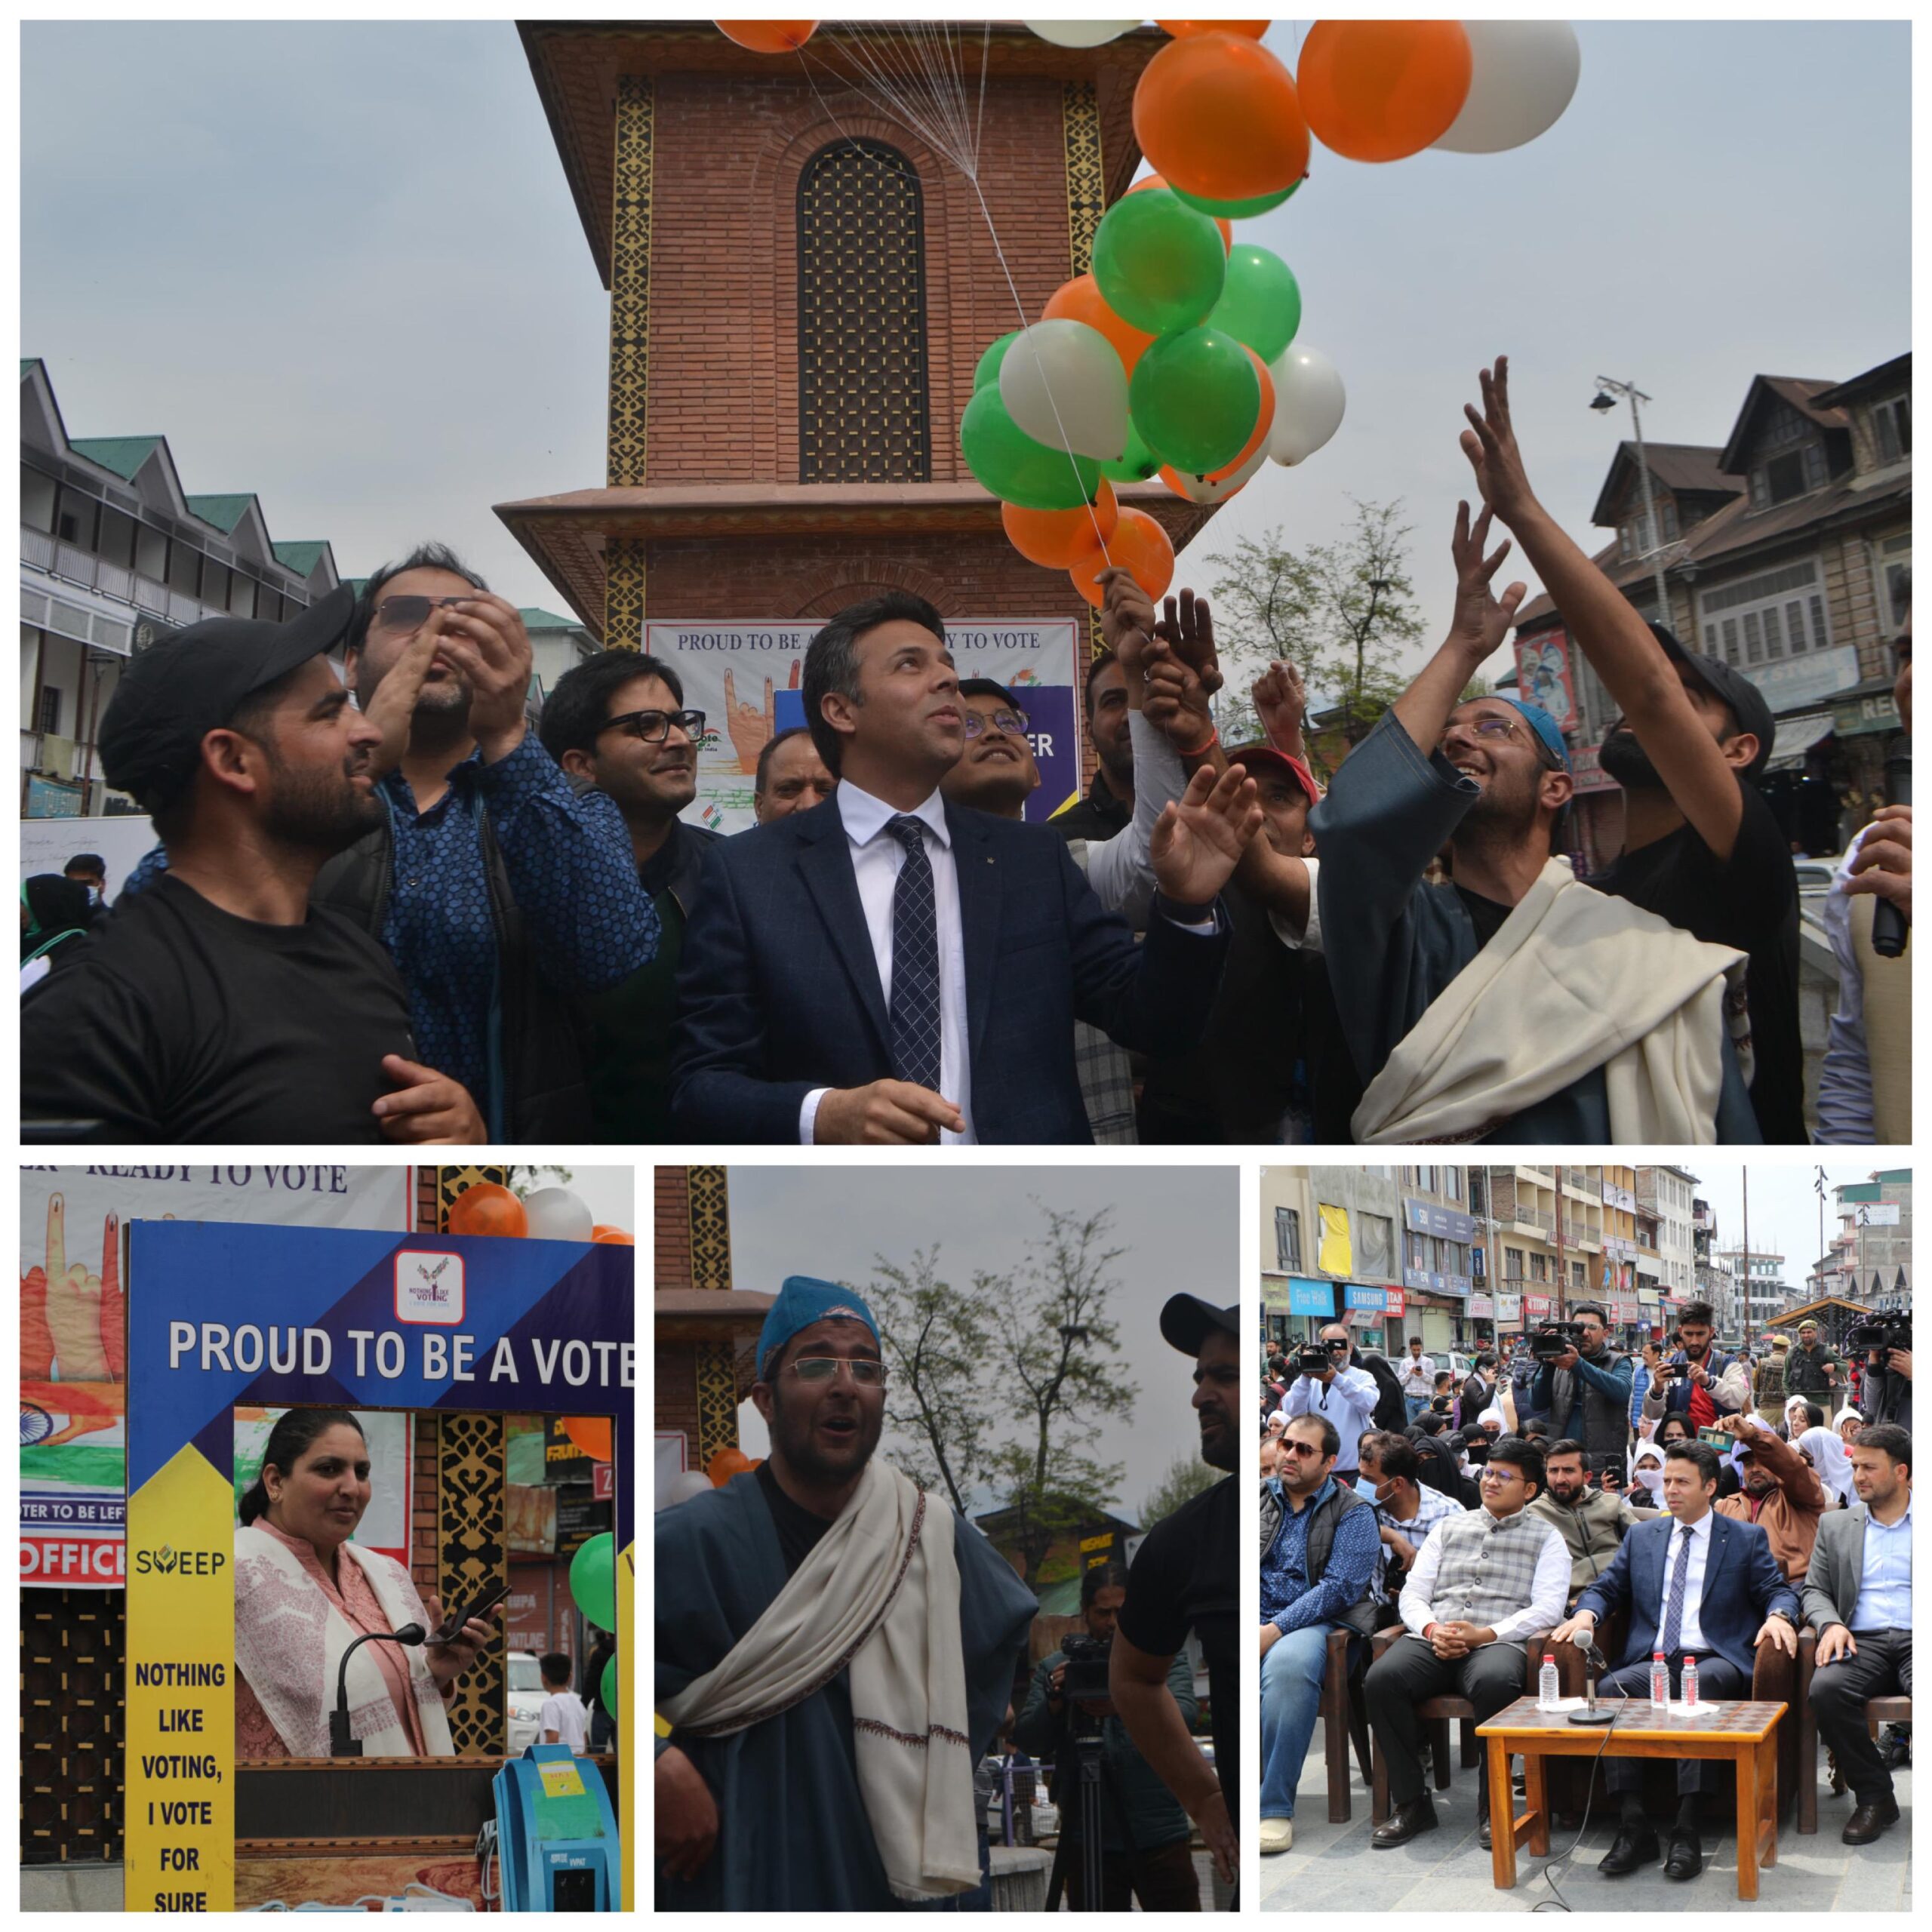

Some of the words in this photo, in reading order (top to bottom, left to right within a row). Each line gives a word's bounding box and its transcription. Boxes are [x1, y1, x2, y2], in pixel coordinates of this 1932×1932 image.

[678, 634, 742, 651] PROUD
[747, 634, 773, 650] TO
[778, 634, 801, 650] BE
[961, 633, 987, 649] TO
[992, 632, 1040, 649] VOTE
[264, 1165, 348, 1193] VOTE
[1352, 1291, 1383, 1306] SAMSUNG
[170, 1321, 332, 1375] PROUD
[348, 1330, 406, 1380] TO
[423, 1333, 475, 1381] BE
[489, 1337, 520, 1383] A
[20, 1504, 48, 1518] TER
[52, 1505, 72, 1518] TO
[78, 1506, 95, 1518] BE
[136, 1549, 226, 1576] SWEEP
[136, 1663, 225, 1687] NOTHING
[158, 1709, 204, 1732] LIKE
[141, 1755, 222, 1783] VOTING,
[149, 1802, 154, 1826] I
[160, 1802, 212, 1825] VOTE
[160, 1848, 199, 1871] FOR
[155, 1892, 207, 1912] SURE
